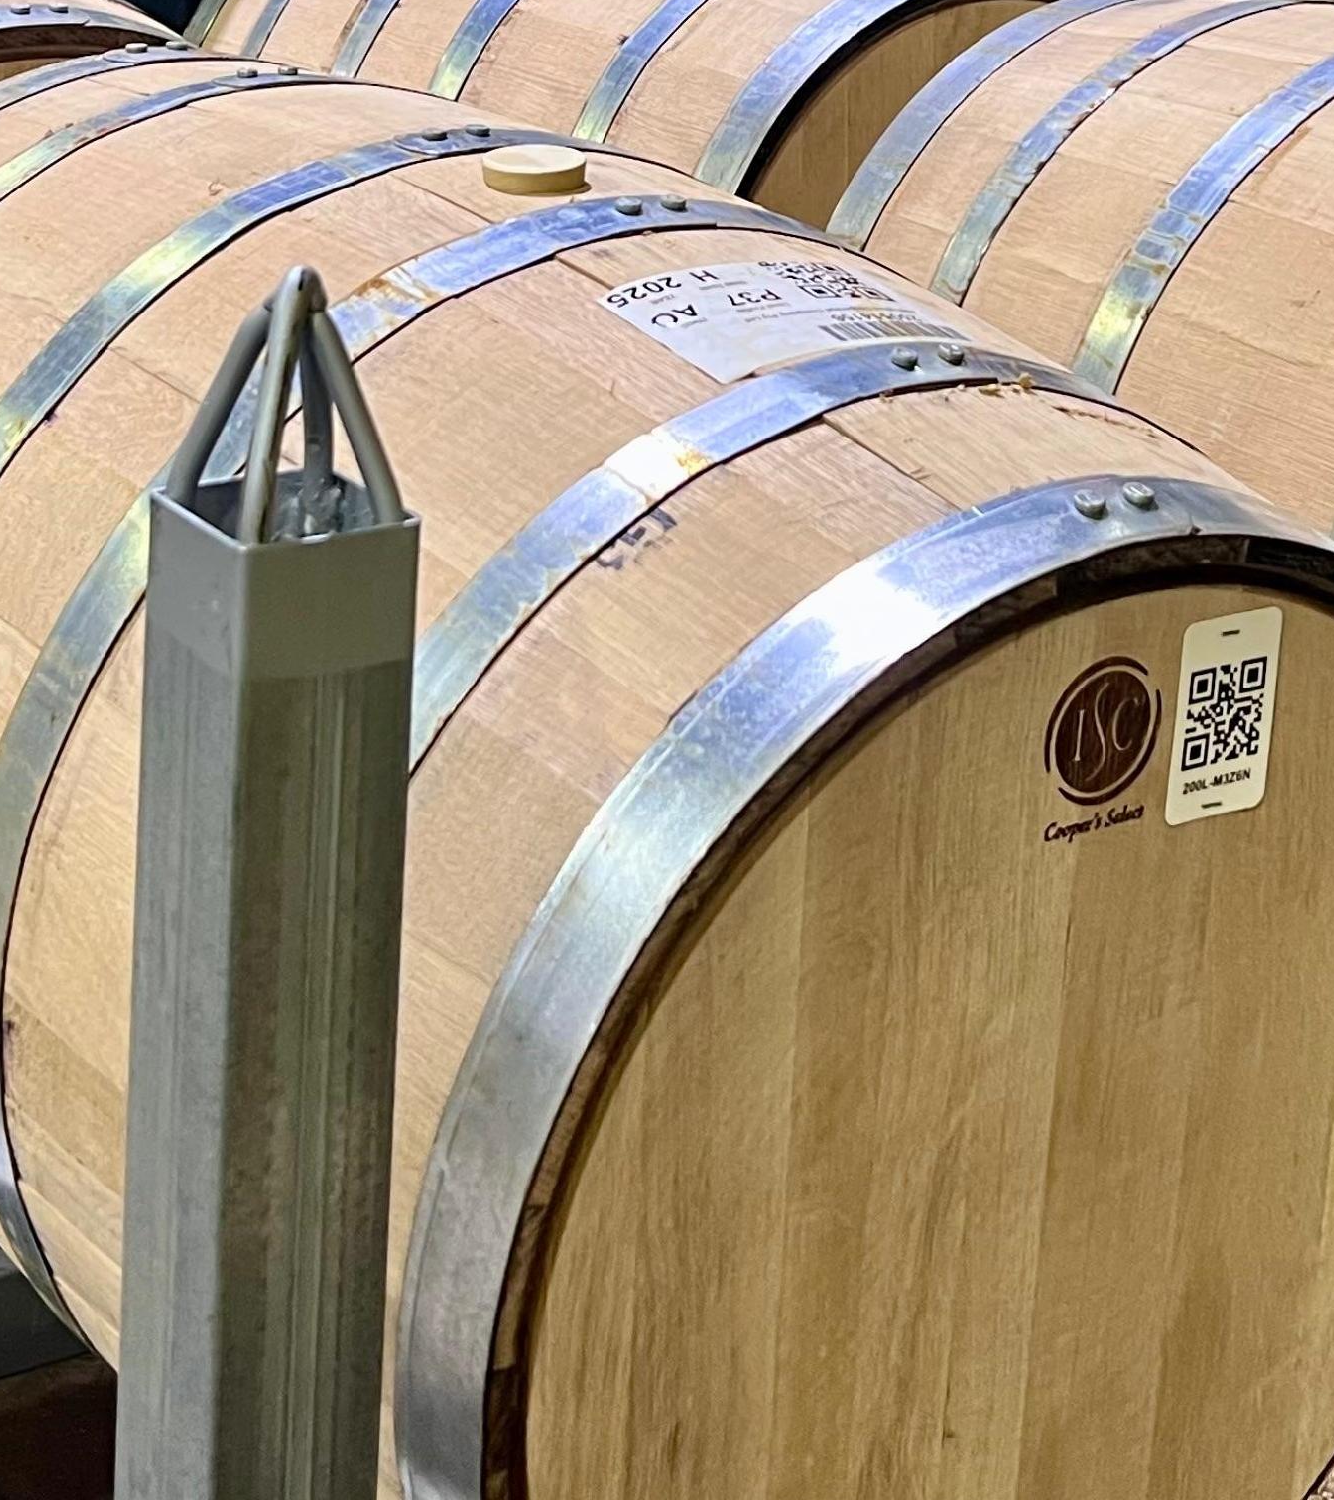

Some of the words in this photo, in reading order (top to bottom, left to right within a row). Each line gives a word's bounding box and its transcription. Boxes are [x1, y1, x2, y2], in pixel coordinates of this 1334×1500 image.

[690, 269, 719, 283] H
[606, 276, 682, 309] 2025
[729, 288, 782, 307] P37
[1043, 812, 1102, 843] Cooper's
[1104, 804, 1145, 828] Select
